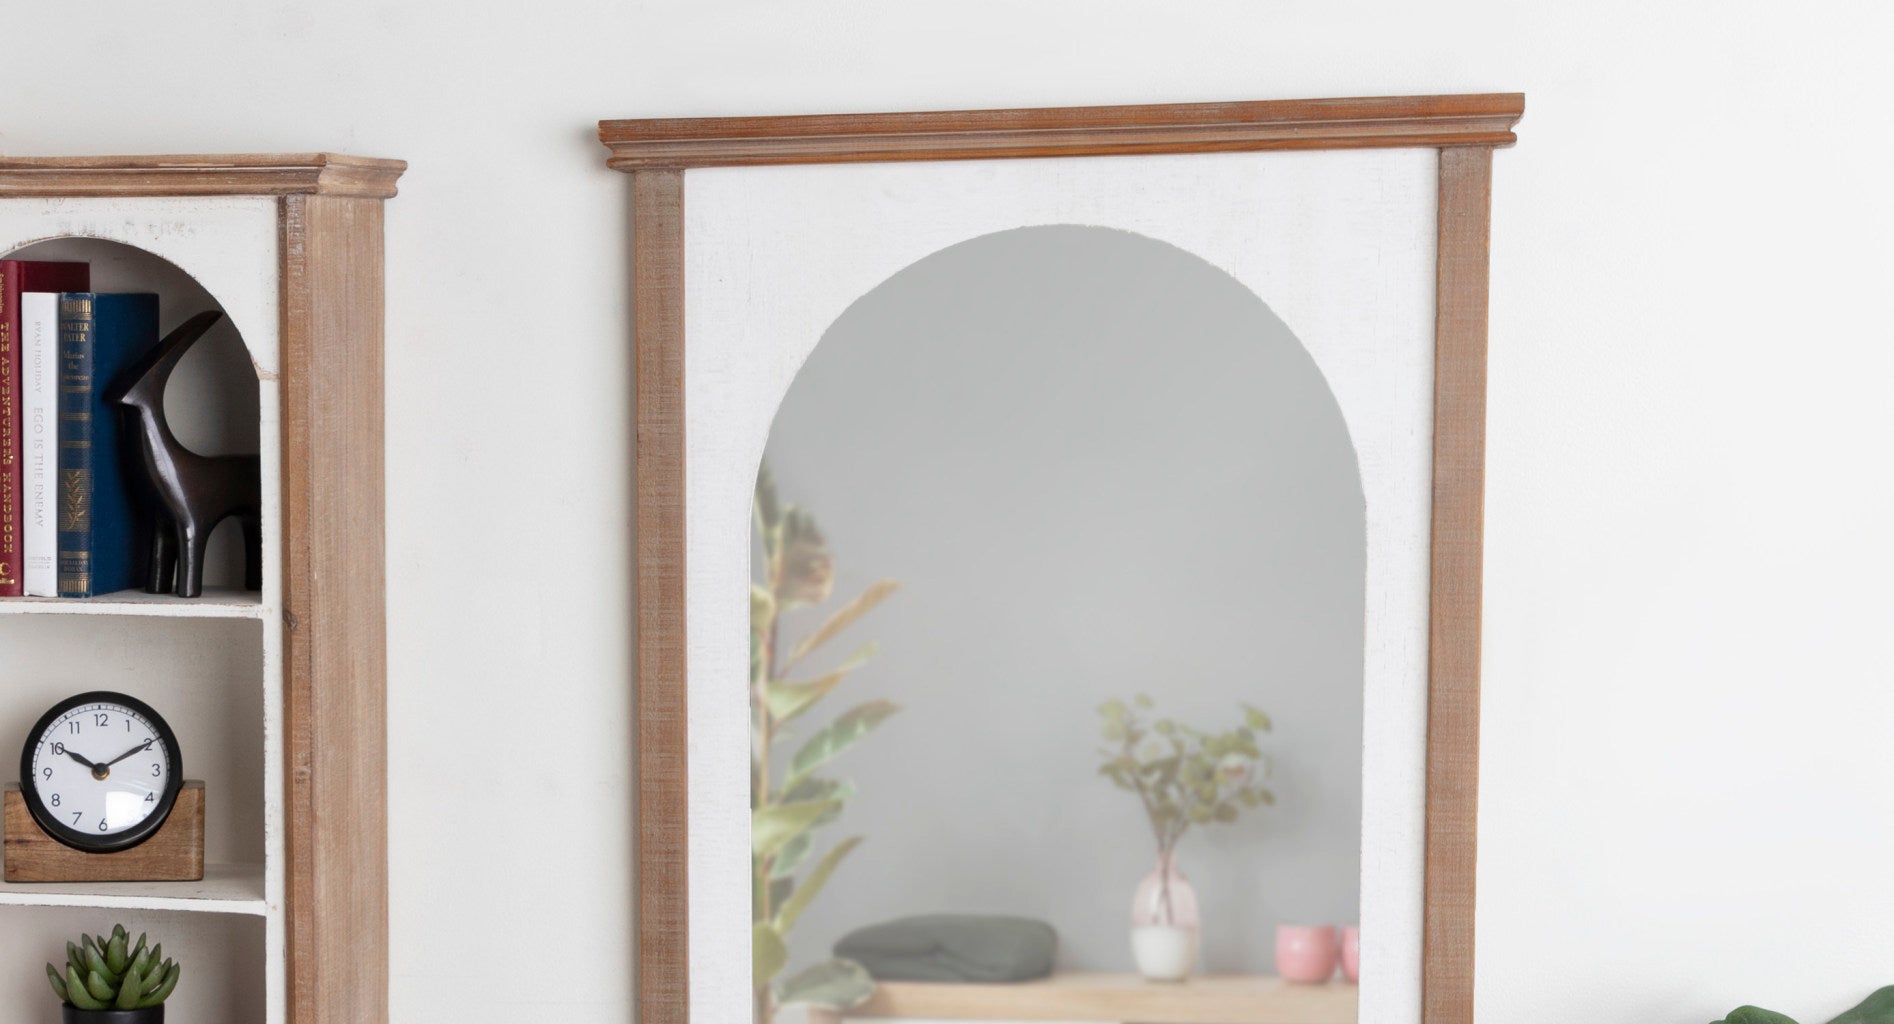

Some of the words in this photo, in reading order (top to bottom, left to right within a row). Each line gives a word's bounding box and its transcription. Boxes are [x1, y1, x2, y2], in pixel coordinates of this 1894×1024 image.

[0, 321, 10, 352] THE
[34, 321, 42, 346] RYAN
[34, 350, 42, 393] HOLIDAY
[34, 407, 43, 434] EGO
[34, 439, 43, 449] IS
[34, 454, 43, 479] THE
[2, 472, 13, 553] HANDBOOK
[34, 484, 43, 527] ENEMY
[94, 713, 108, 727] 12
[126, 720, 131, 732] 1
[69, 721, 80, 734] 11
[50, 742, 64, 755] 10
[144, 738, 153, 751] 2
[43, 767, 53, 781] 9
[152, 763, 161, 777] 3
[51, 793, 61, 807] 8
[145, 792, 154, 802] 4
[72, 812, 82, 825] 7
[98, 818, 108, 832] 6
